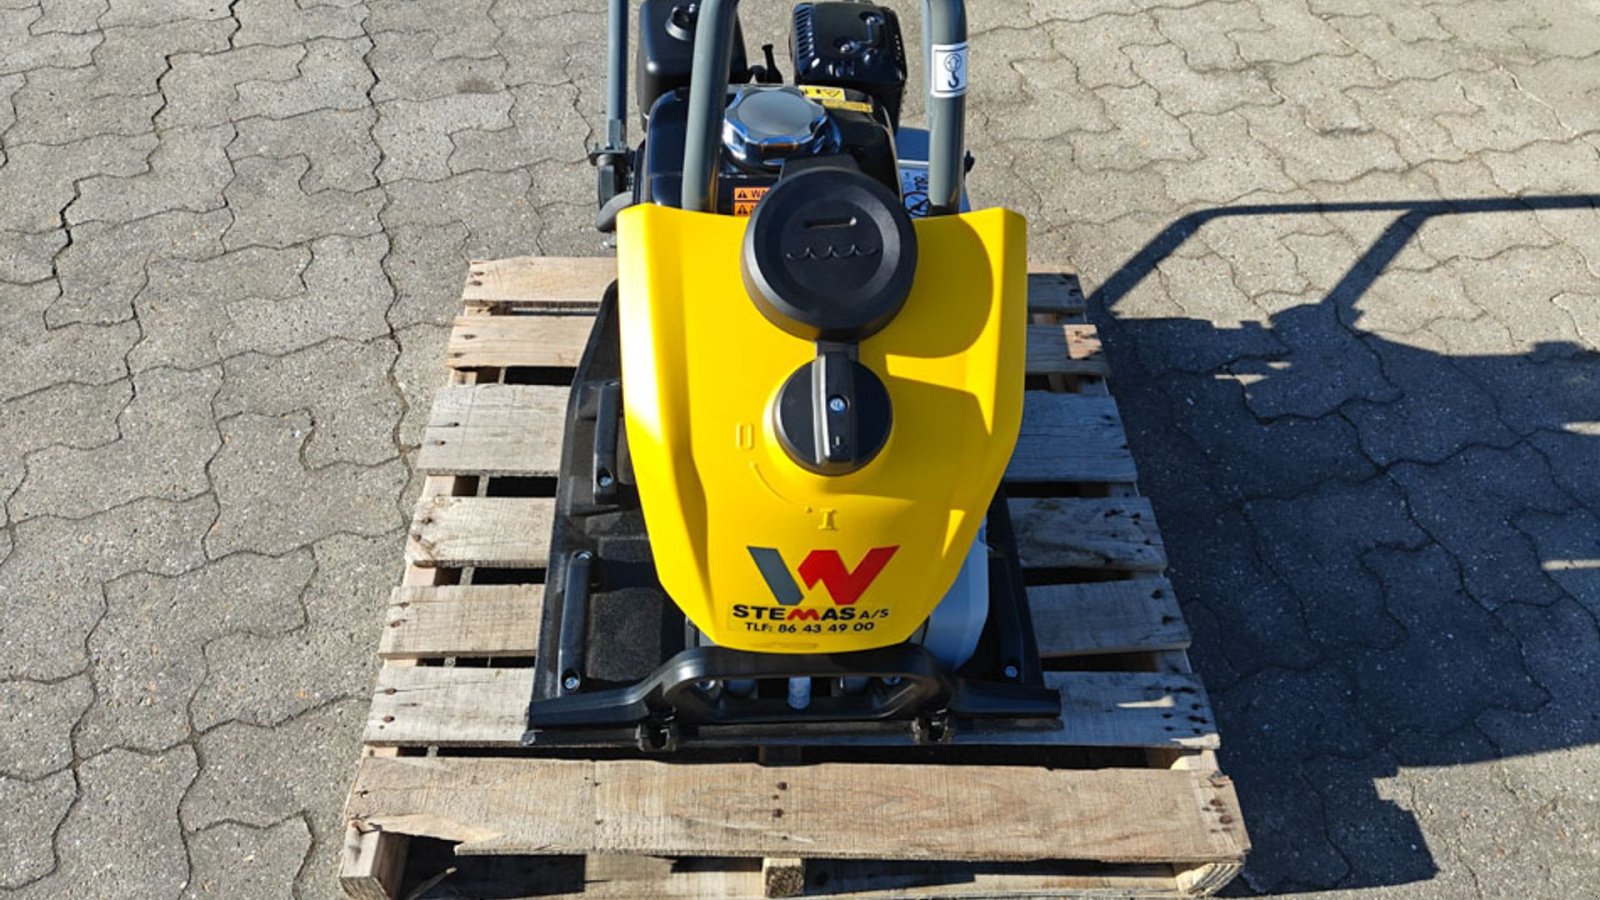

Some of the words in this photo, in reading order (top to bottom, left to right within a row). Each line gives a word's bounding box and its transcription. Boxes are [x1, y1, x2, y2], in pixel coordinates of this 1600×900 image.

[732, 604, 856, 622] STEMAS
[858, 608, 889, 620] A/S
[778, 623, 797, 633] 86
[802, 623, 822, 633] 43
[828, 623, 848, 633] 49
[853, 622, 875, 632] 00
